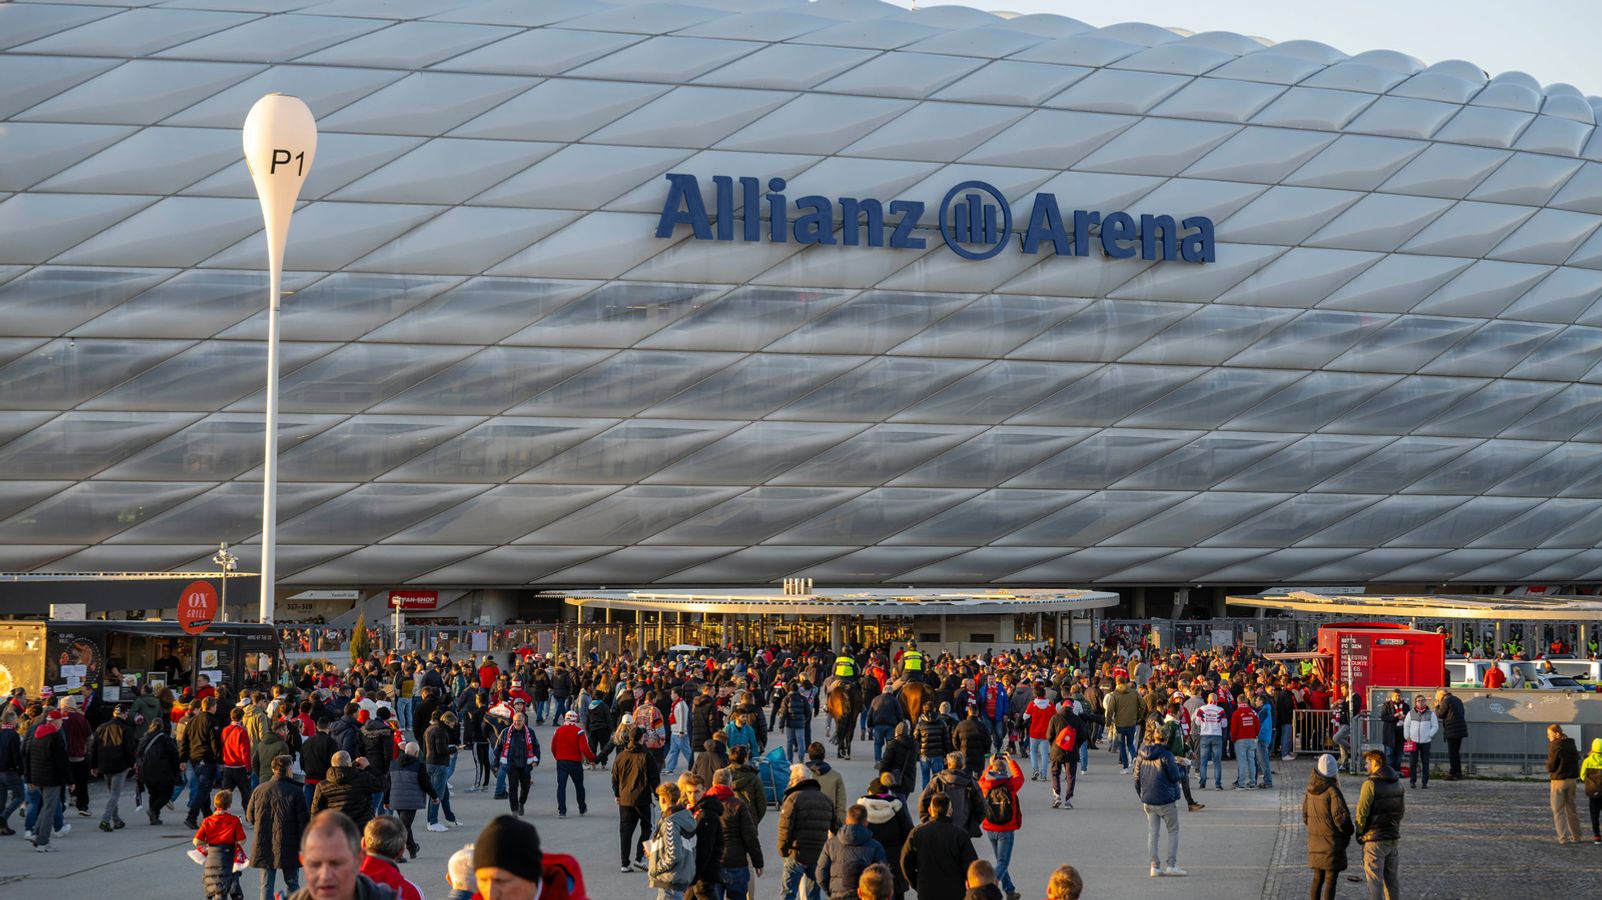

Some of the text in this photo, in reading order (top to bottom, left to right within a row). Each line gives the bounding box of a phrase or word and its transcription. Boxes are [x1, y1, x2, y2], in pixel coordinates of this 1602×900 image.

[270, 149, 305, 177] P1
[655, 172, 1216, 263] Allianz Arena
[188, 592, 209, 608] OX
[187, 609, 207, 618] GRILL
